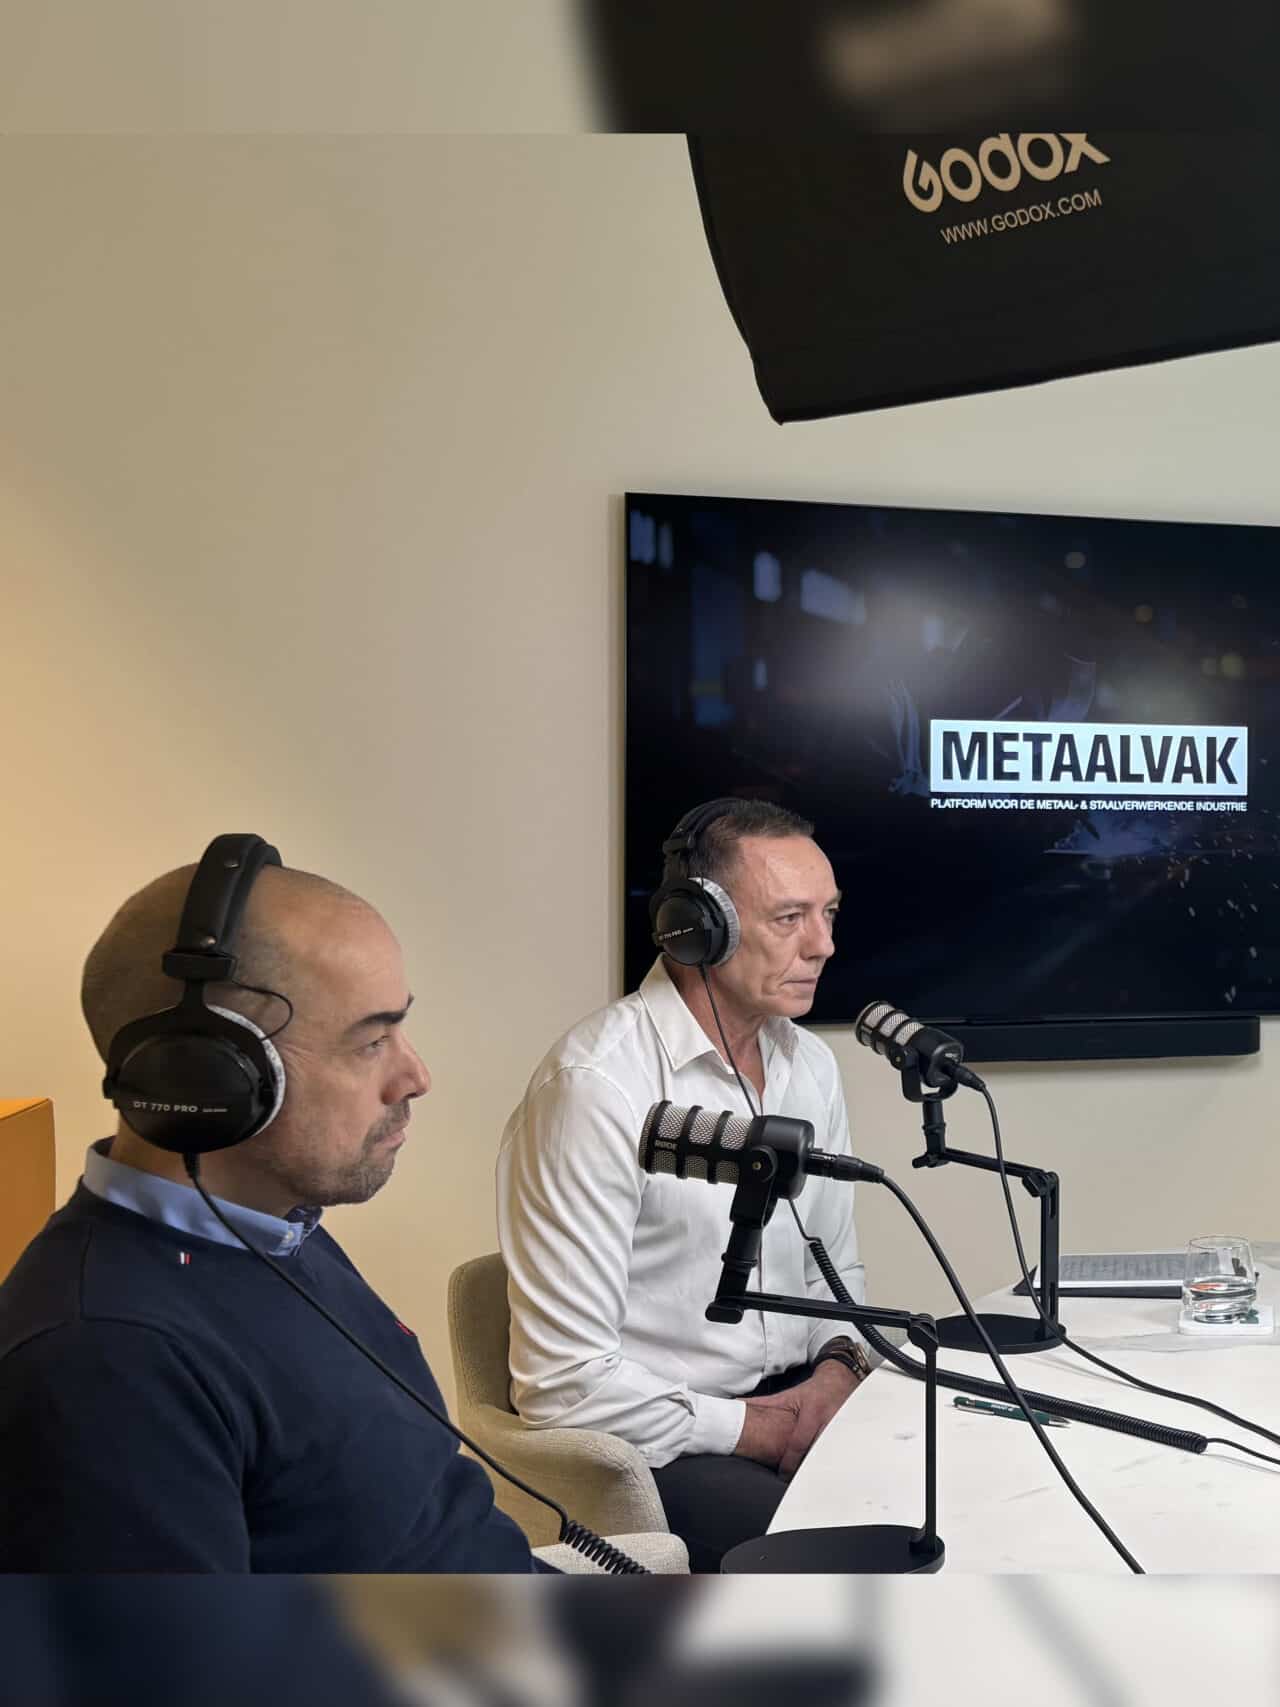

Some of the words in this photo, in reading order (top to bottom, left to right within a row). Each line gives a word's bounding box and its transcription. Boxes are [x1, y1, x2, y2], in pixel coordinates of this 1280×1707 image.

[940, 188, 1103, 245] WWW.GODOX.COM
[941, 730, 1240, 785] METAALVAK
[930, 798, 987, 809] PLATFORM
[988, 799, 1018, 810] VOOR
[1020, 799, 1035, 810] DE
[1036, 799, 1079, 811] METAAL-
[1080, 800, 1088, 811] &
[1089, 800, 1195, 812] STAALVERWERKENDE
[1196, 800, 1248, 812] INDUSTRIE
[151, 1103, 171, 1112] 770
[173, 1104, 199, 1113] PRO
